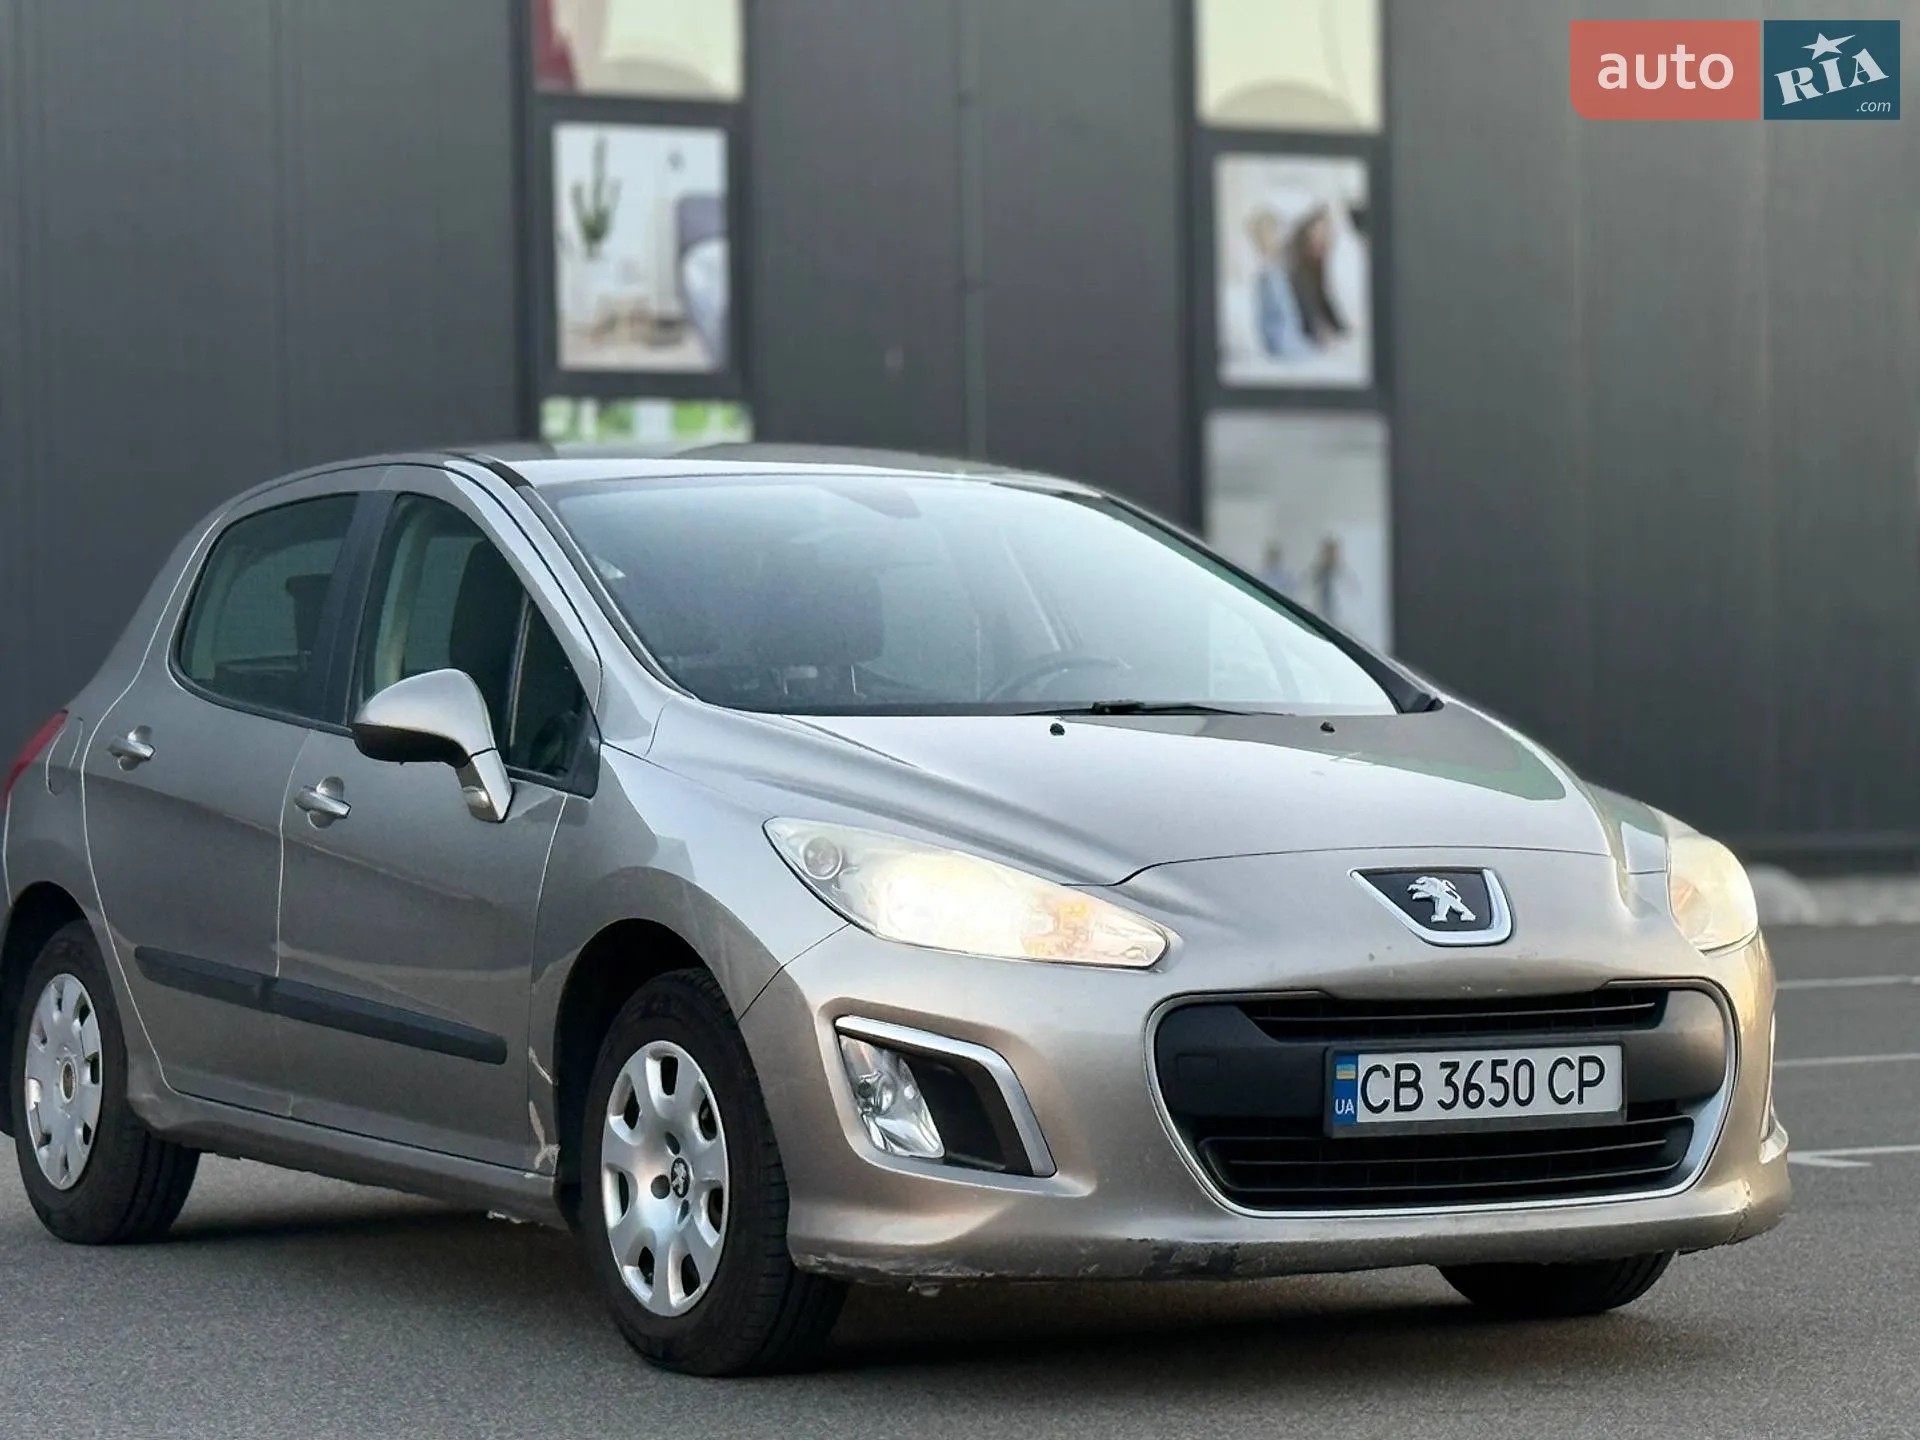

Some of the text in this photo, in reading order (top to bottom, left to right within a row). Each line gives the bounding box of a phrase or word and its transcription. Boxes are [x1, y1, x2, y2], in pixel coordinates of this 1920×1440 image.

[1360, 1055, 1606, 1114] CB 3650 CP
[1334, 1097, 1356, 1116] UA
